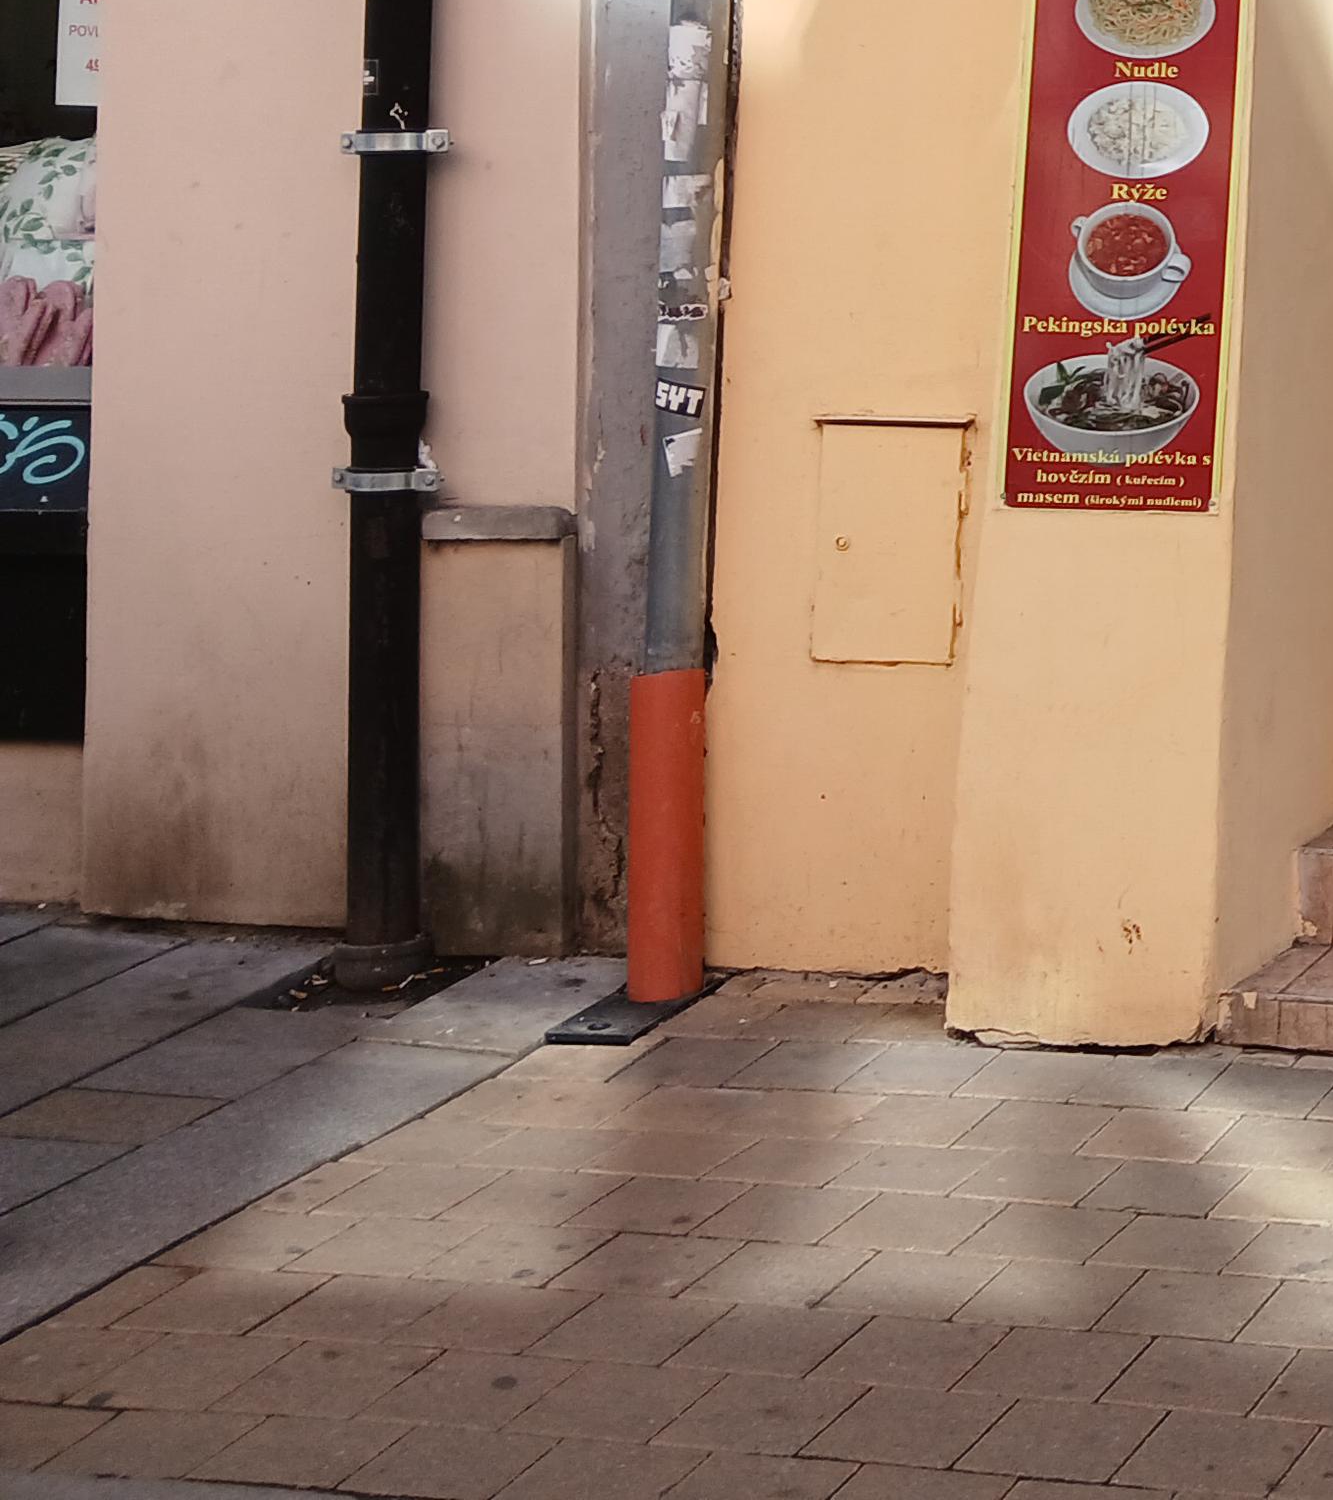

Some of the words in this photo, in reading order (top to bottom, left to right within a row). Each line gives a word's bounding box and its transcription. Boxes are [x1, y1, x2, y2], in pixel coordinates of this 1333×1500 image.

[1114, 61, 1179, 78] Nudle
[1109, 183, 1168, 206] Rýže
[1022, 314, 1130, 338] Pekingská
[1131, 318, 1215, 340] polévka
[1011, 444, 1122, 464] Vietnamská
[1122, 445, 1197, 468] polévka
[1036, 469, 1111, 484] hovězím
[1124, 474, 1176, 486] kuřecím
